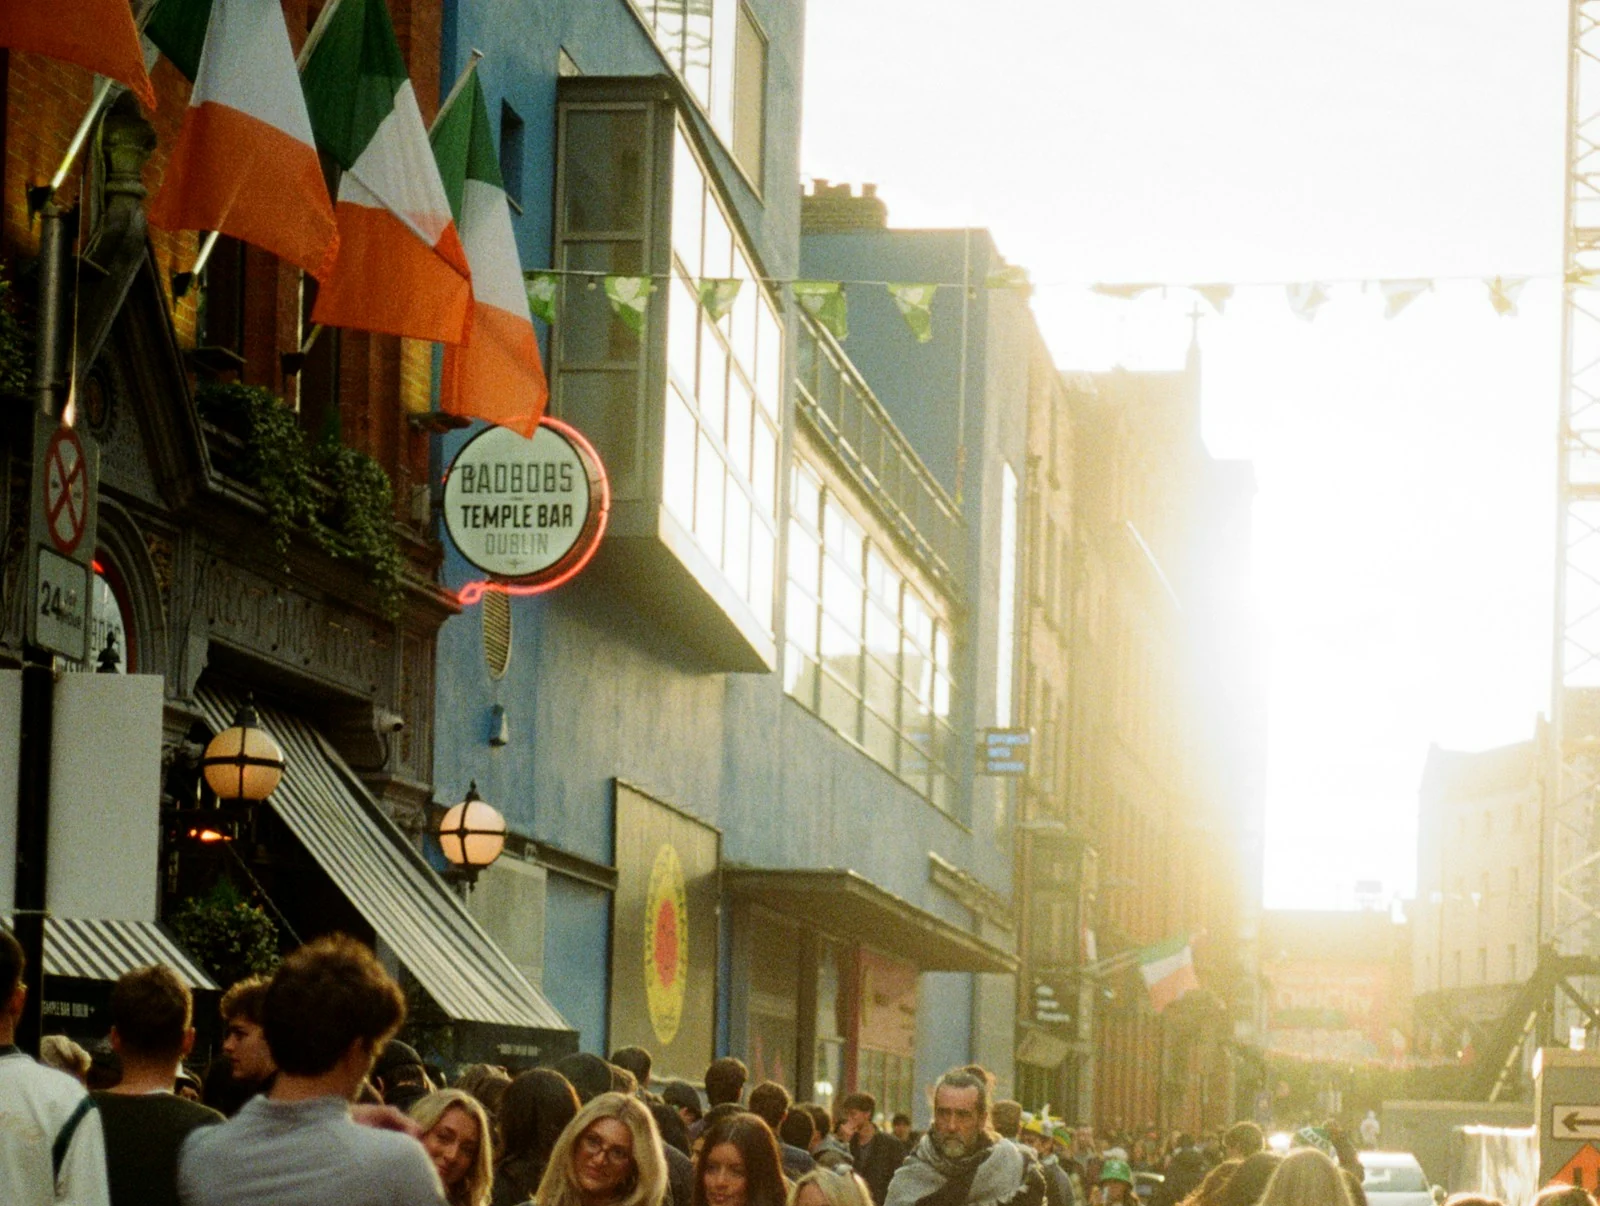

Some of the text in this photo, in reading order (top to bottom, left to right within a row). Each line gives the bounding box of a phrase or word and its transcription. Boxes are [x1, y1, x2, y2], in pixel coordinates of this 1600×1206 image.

[461, 503, 573, 529] TEMPLE BAR
[484, 532, 549, 556] DUBLIN
[41, 580, 62, 617] 24
